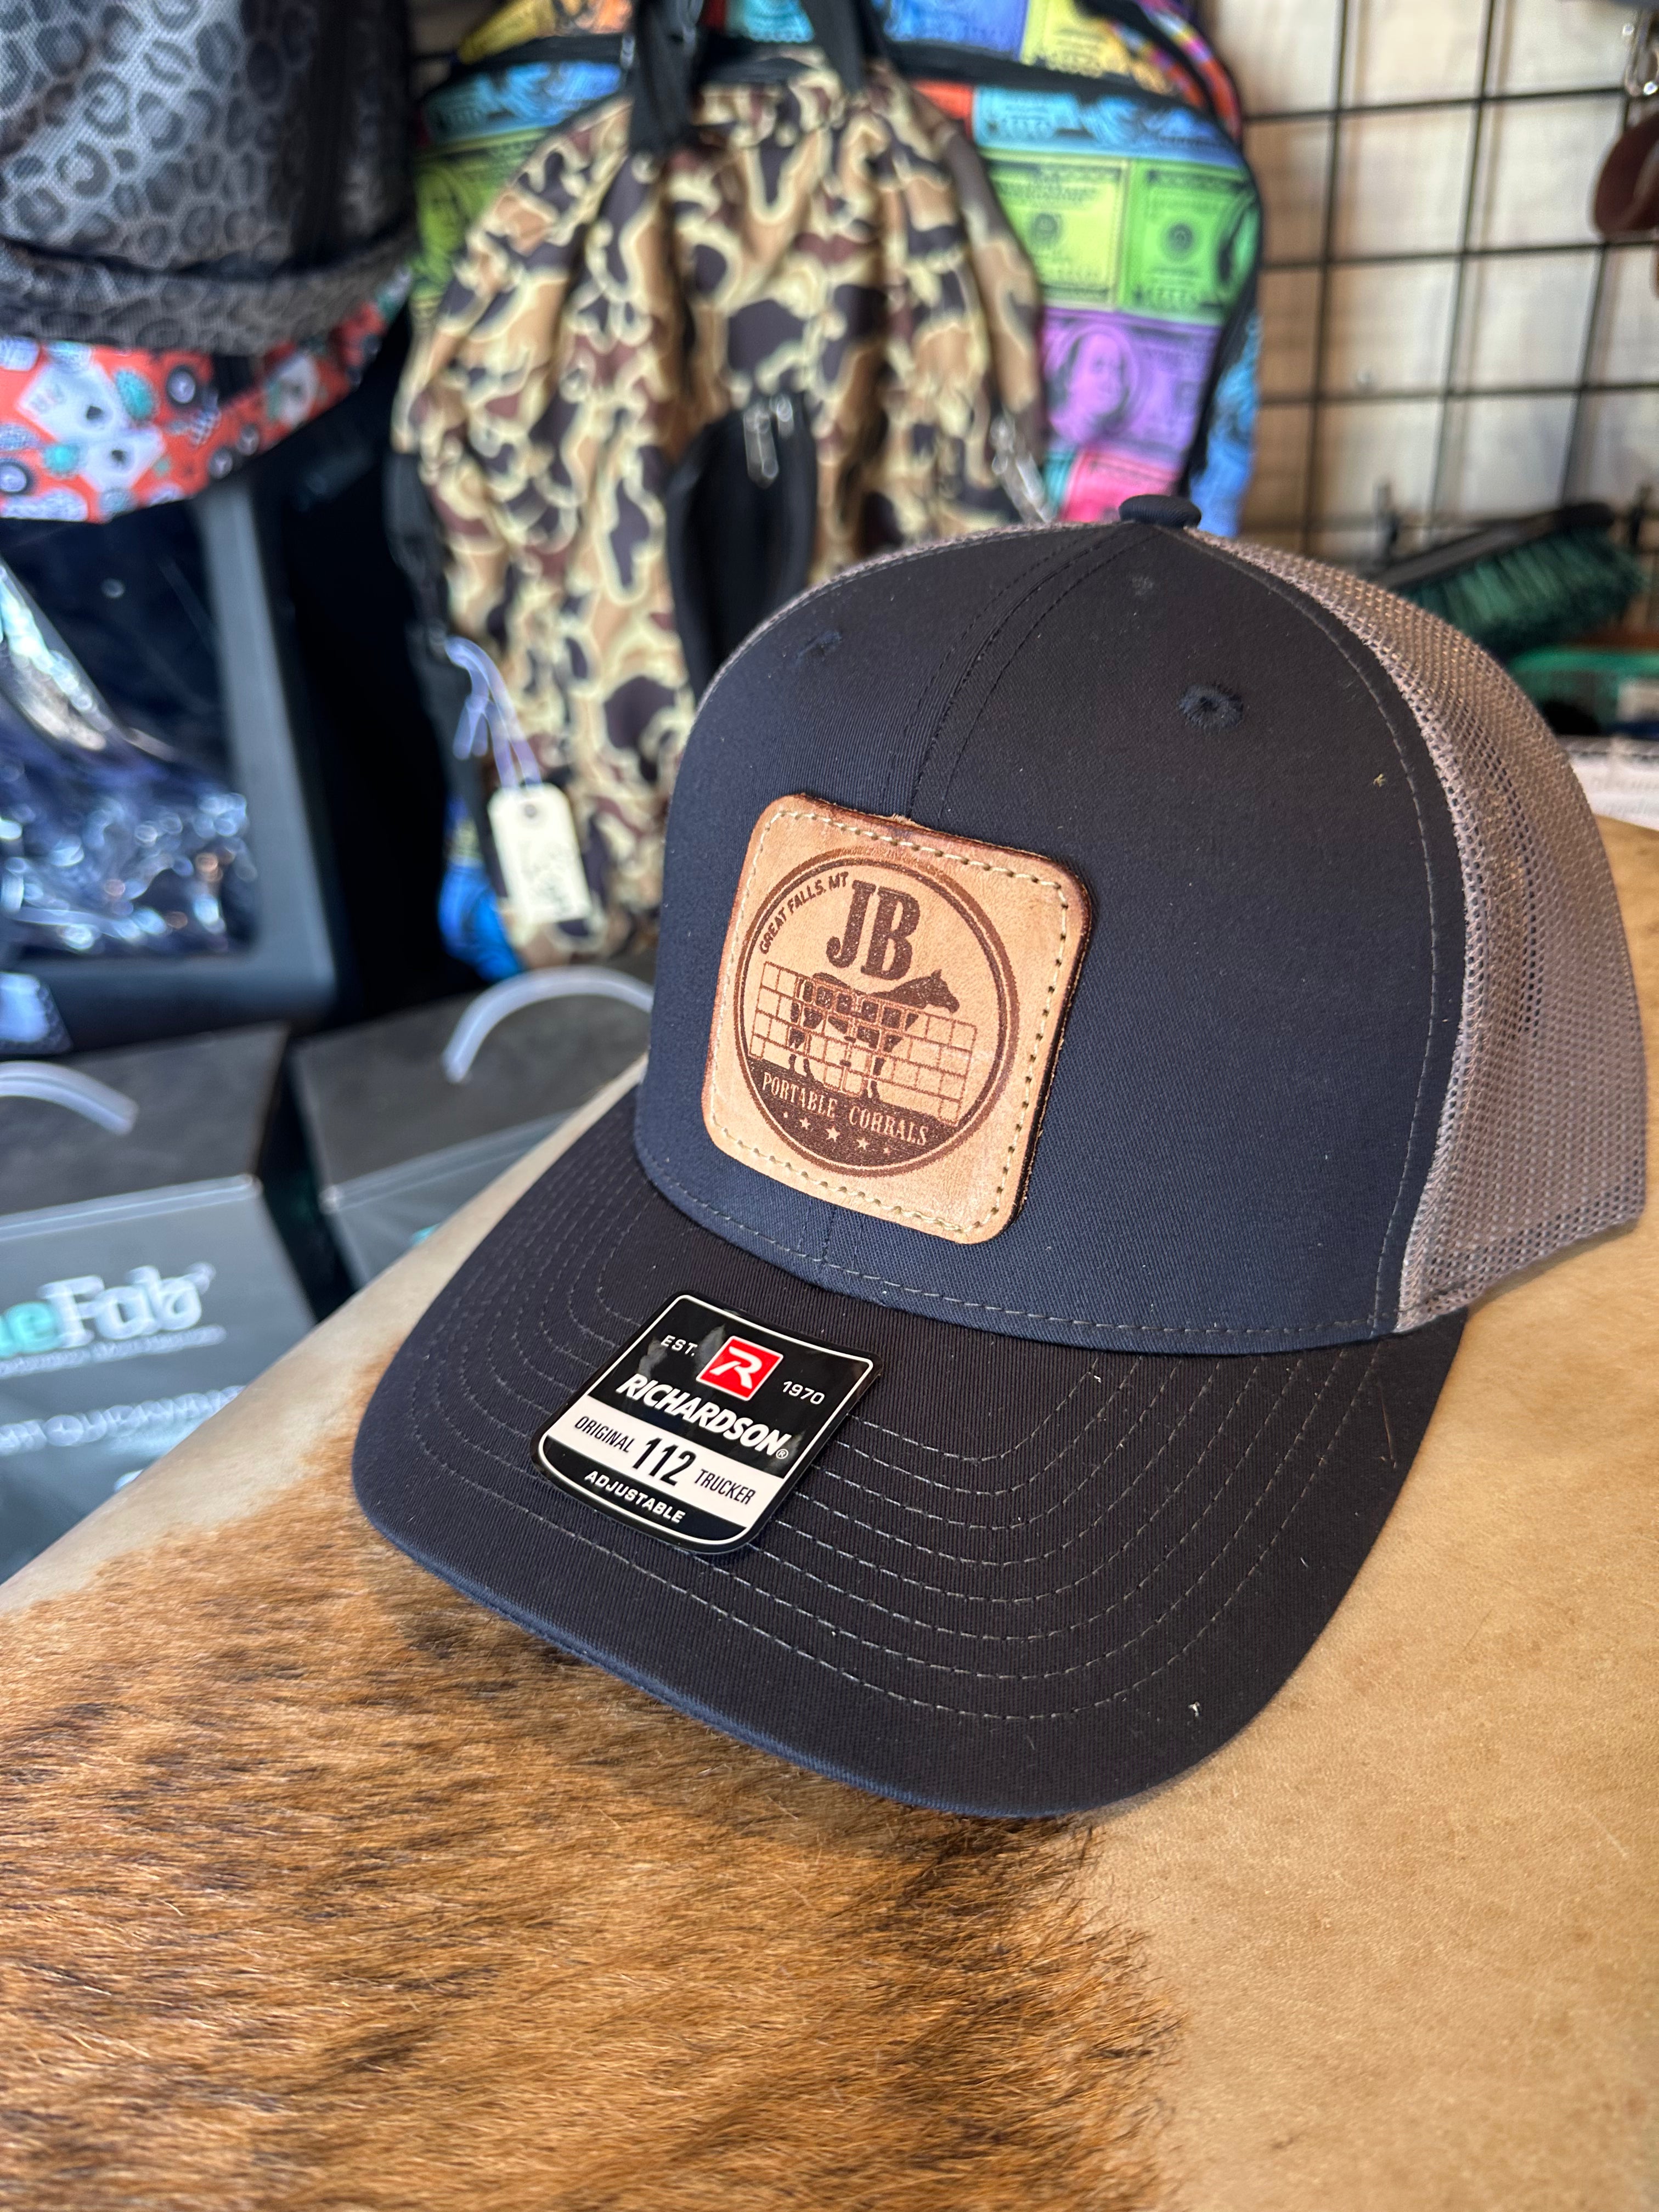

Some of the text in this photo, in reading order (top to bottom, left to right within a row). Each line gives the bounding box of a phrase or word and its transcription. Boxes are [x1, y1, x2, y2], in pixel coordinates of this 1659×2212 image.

[759, 907, 787, 954] GREAT
[828, 871, 849, 891] MT
[826, 879, 920, 980] JB
[763, 1071, 929, 1146] PORTABLE CORRALS
[661, 1335, 698, 1356] EST.
[783, 1381, 825, 1405] 1970
[575, 1416, 756, 1505] ORIGINAL 112 TRUCKER
[584, 1470, 686, 1523] ADJUSTABLE
